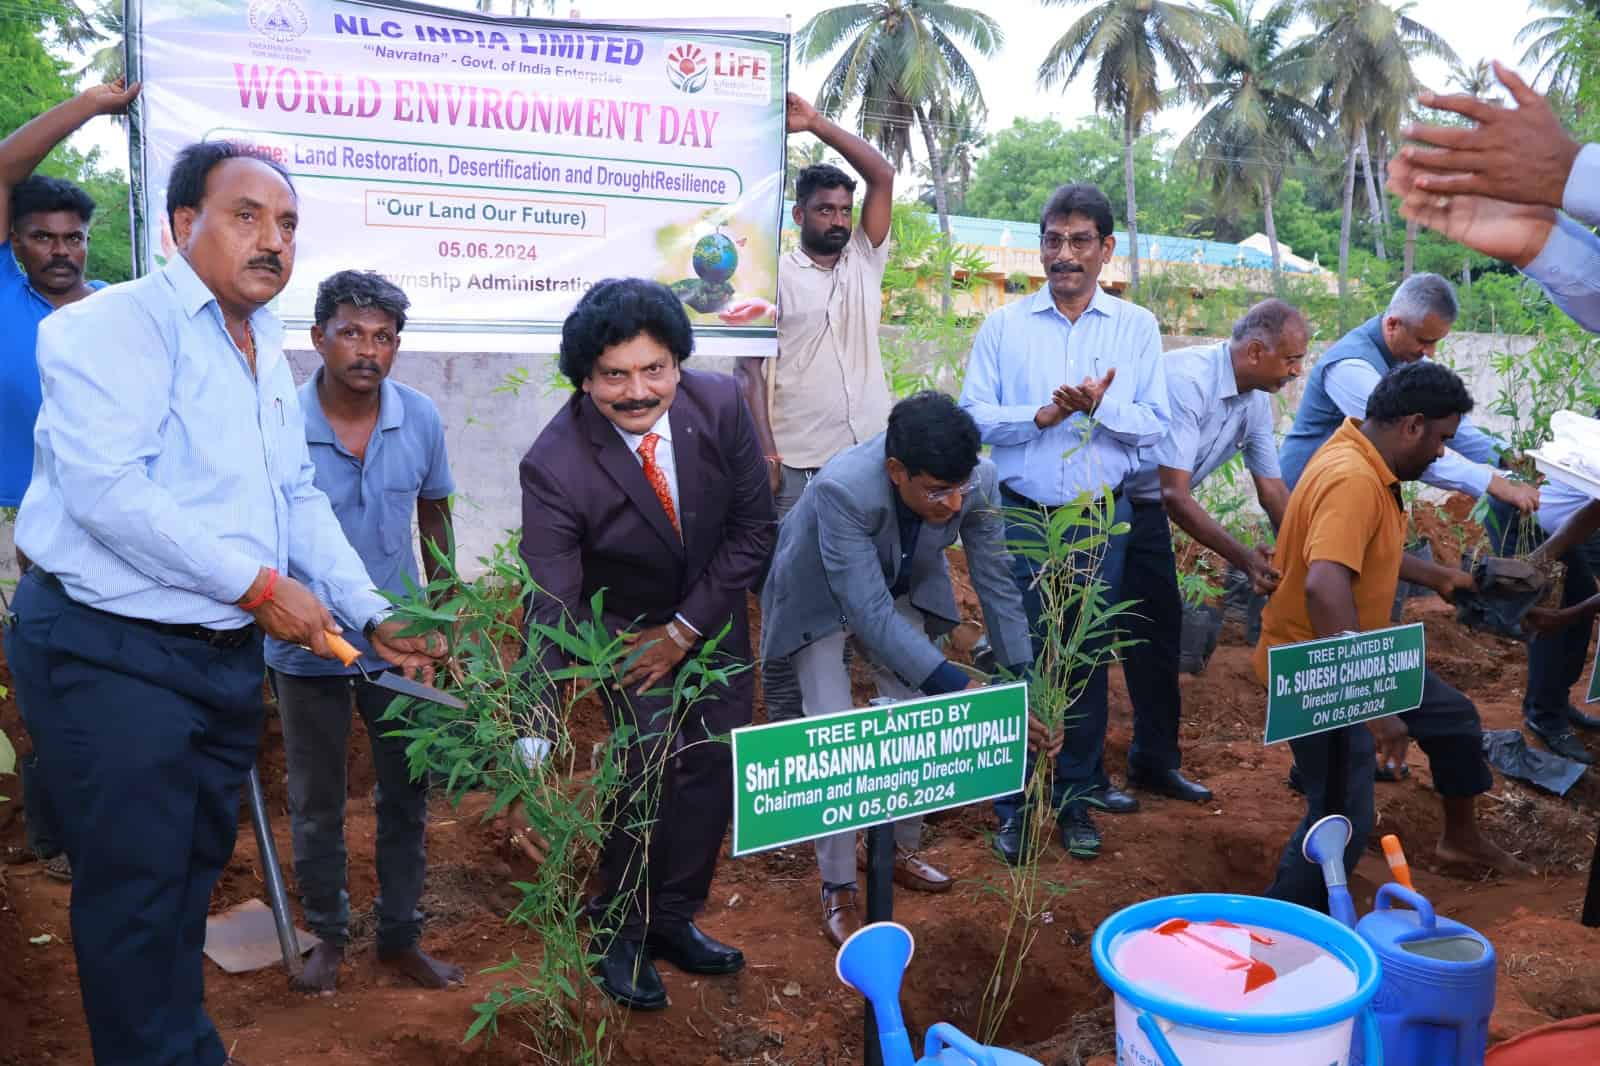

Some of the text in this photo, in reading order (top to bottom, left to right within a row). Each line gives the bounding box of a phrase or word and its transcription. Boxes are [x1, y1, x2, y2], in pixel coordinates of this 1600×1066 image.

[334, 13, 403, 39] NLC
[414, 24, 511, 51] INDIA
[519, 32, 644, 66] LIMITED
[461, 55, 497, 71] Govt.
[502, 60, 516, 73] of
[519, 61, 552, 76] India
[556, 65, 623, 84] Enterprise
[233, 63, 720, 149] WORLD ENVIRONMENT DAY
[295, 143, 337, 167] Land
[343, 147, 443, 177] Restoration,
[449, 154, 561, 182] Desertification
[565, 165, 592, 185] and
[597, 165, 726, 194] DroughtResilience
[429, 202, 476, 220] Land
[482, 204, 516, 222] Our
[522, 206, 586, 230] Future)
[438, 241, 537, 261] 05.06.2024
[467, 273, 593, 293] Administratio
[1277, 648, 1420, 697] Dr. SURESH CHANDRA SUMAN
[1307, 637, 1395, 665] TREE PLANTED BY
[1302, 676, 1398, 710] Director / Mines, NLCIL
[1313, 698, 1385, 727] ON 05.06.2024
[805, 702, 971, 748] TREE PLANTED BY
[745, 715, 1021, 793] Shri PRASANNA KUMAR MOTUPALLI
[753, 746, 1013, 816] Chairman and Managing Director, NLCIL
[822, 782, 956, 826] ON 05.06.2024
